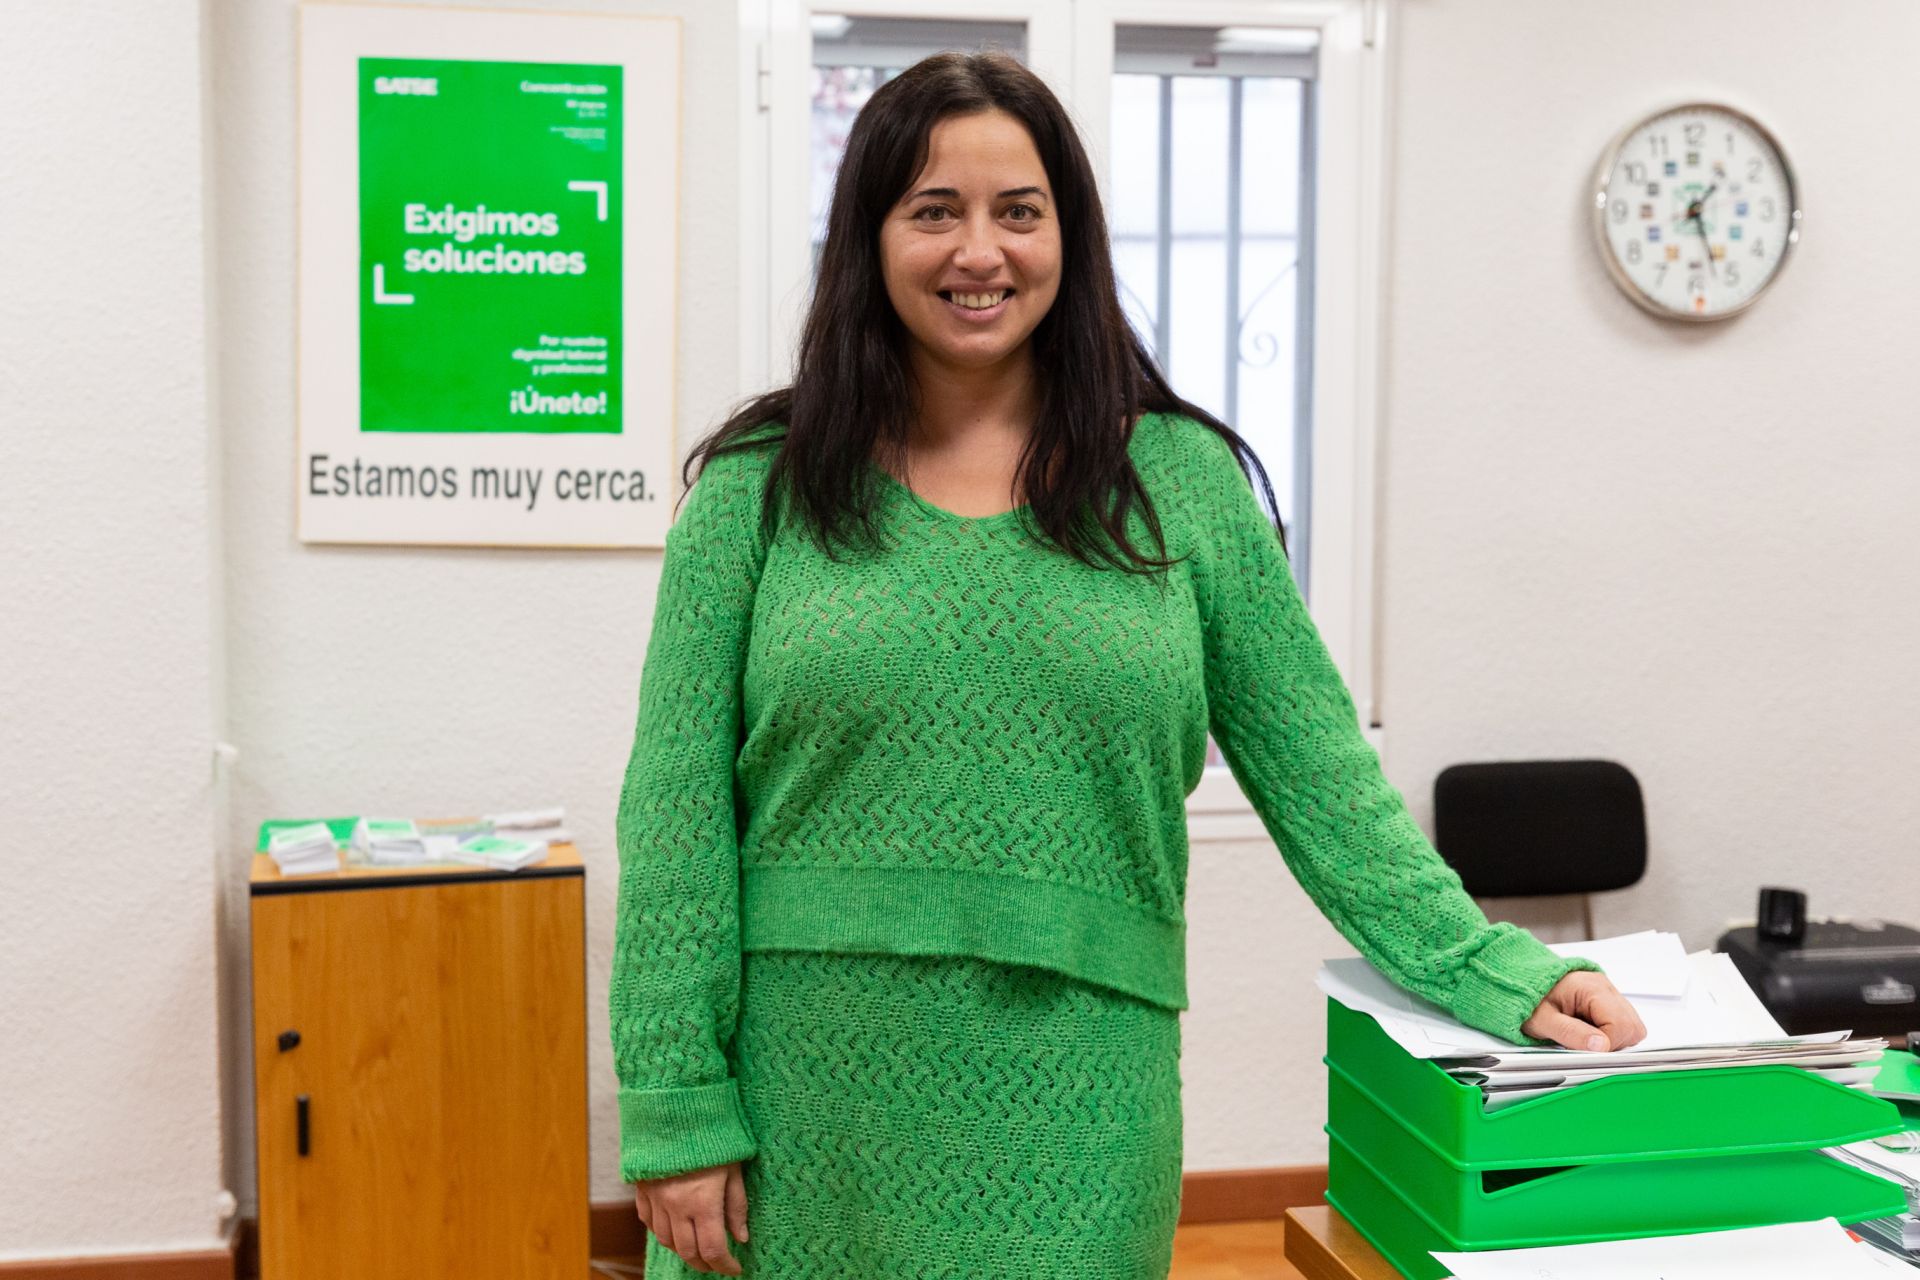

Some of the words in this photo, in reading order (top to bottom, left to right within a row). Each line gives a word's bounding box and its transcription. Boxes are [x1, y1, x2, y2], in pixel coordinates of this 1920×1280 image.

[1648, 134, 1670, 158] 11
[1683, 121, 1706, 149] 12
[1725, 131, 1736, 155] 1
[1623, 161, 1649, 187] 10
[1746, 155, 1765, 184] 2
[404, 203, 560, 242] Exigimos
[1611, 197, 1630, 225] 9
[1758, 195, 1777, 223] 3
[404, 242, 587, 275] soluciones
[1625, 237, 1644, 266] 8
[1749, 236, 1766, 259] 4
[1652, 261, 1671, 289] 7
[1723, 260, 1742, 288] 5
[510, 384, 608, 415] ¡Únete!
[309, 454, 459, 498] Estamos
[471, 464, 543, 511] muy
[555, 467, 656, 502] cerca.
